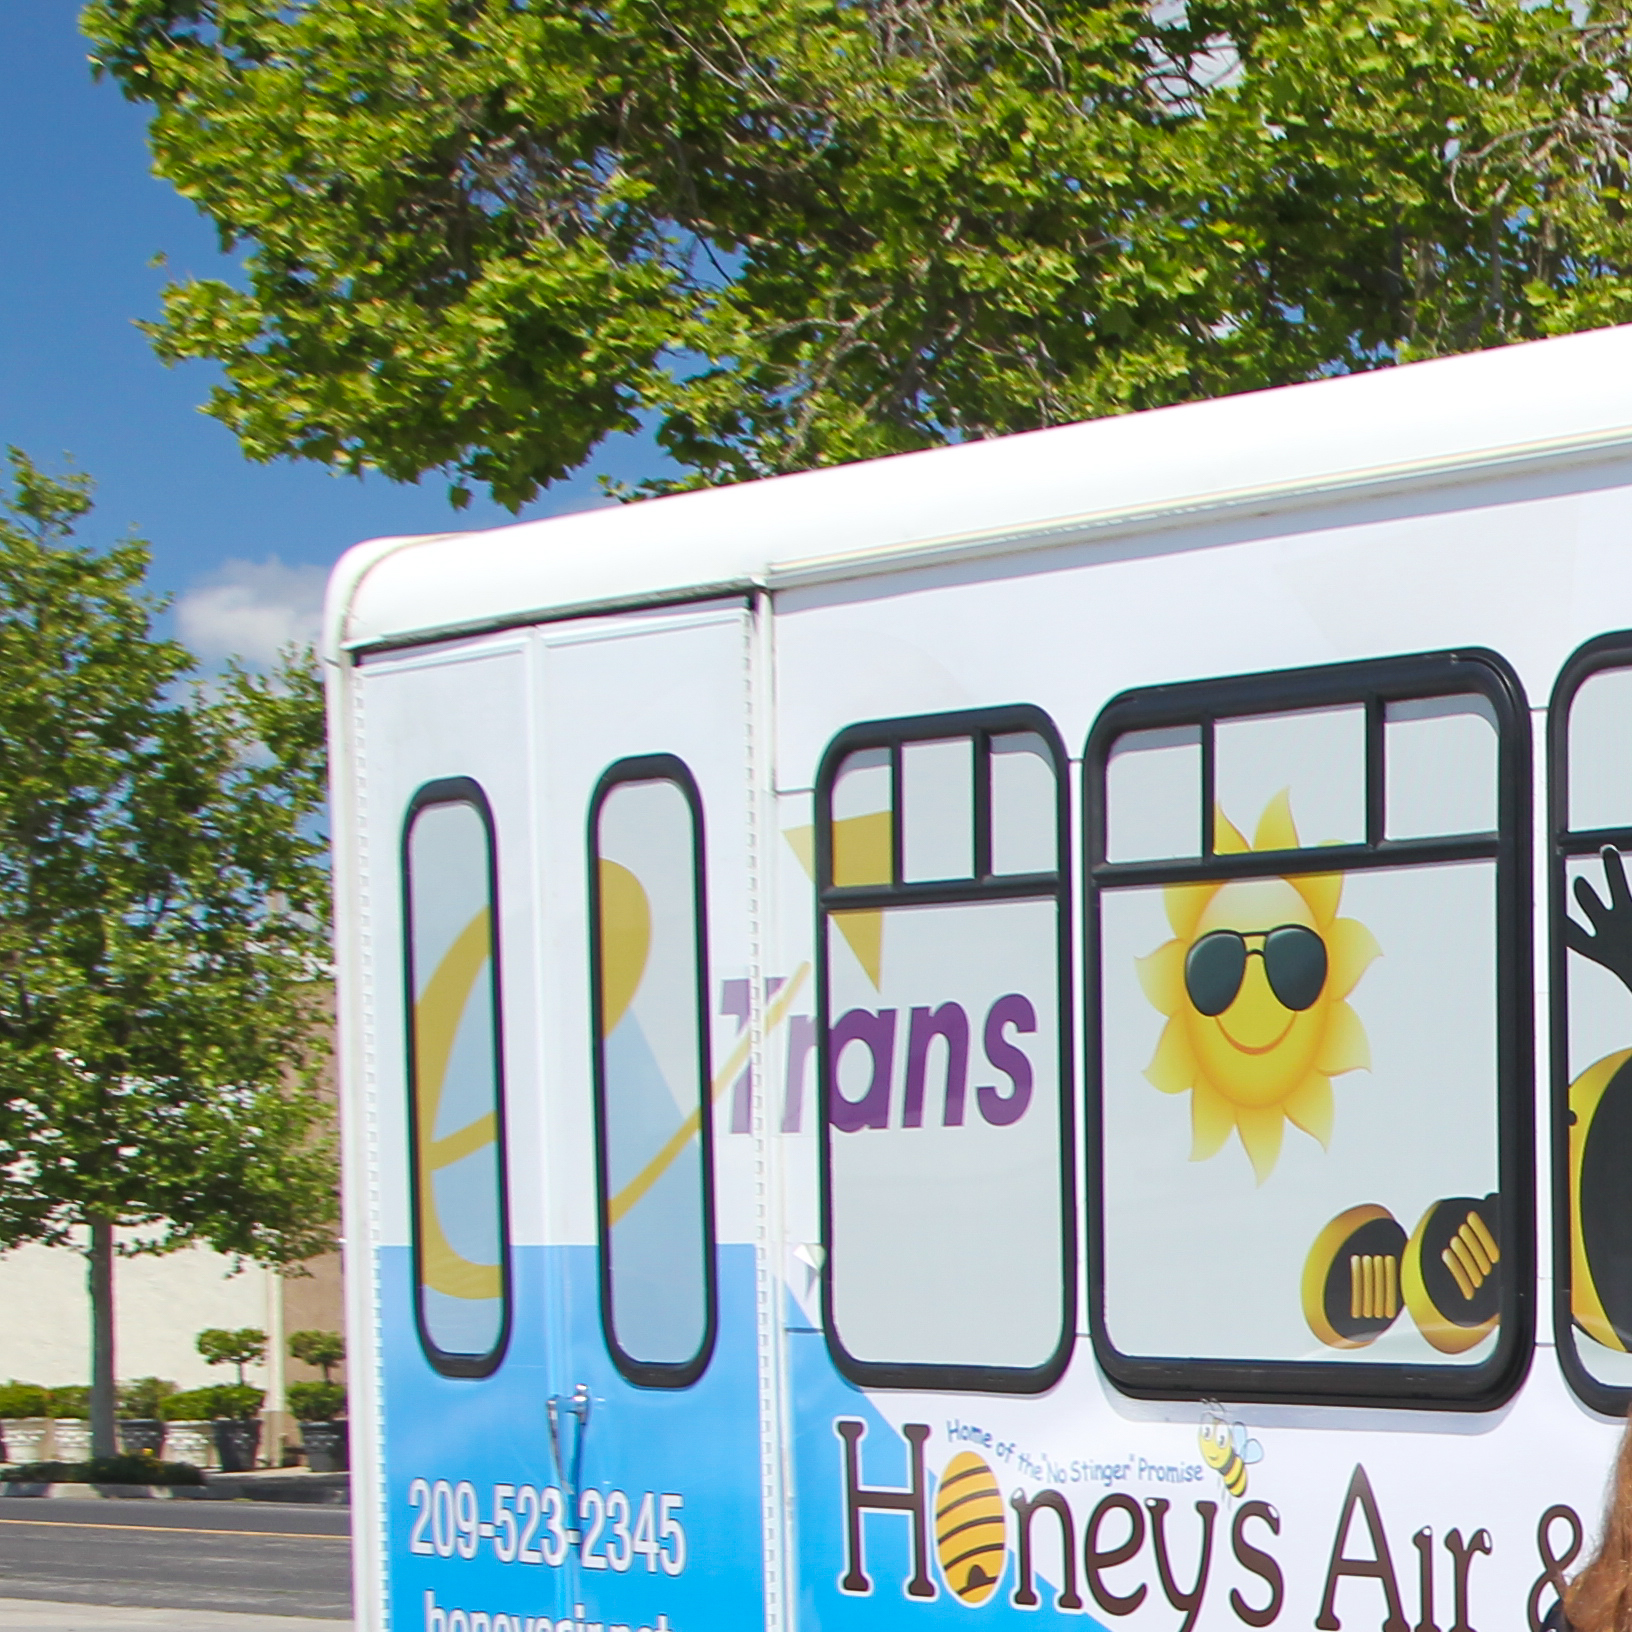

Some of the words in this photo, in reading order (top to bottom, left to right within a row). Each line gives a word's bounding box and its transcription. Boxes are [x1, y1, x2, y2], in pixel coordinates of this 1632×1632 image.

[946, 1419, 993, 1449] Home
[995, 1442, 1017, 1464] of
[1018, 1452, 1043, 1481] the
[1138, 1457, 1205, 1484] Promise
[408, 1478, 687, 1577] 209-523-2345
